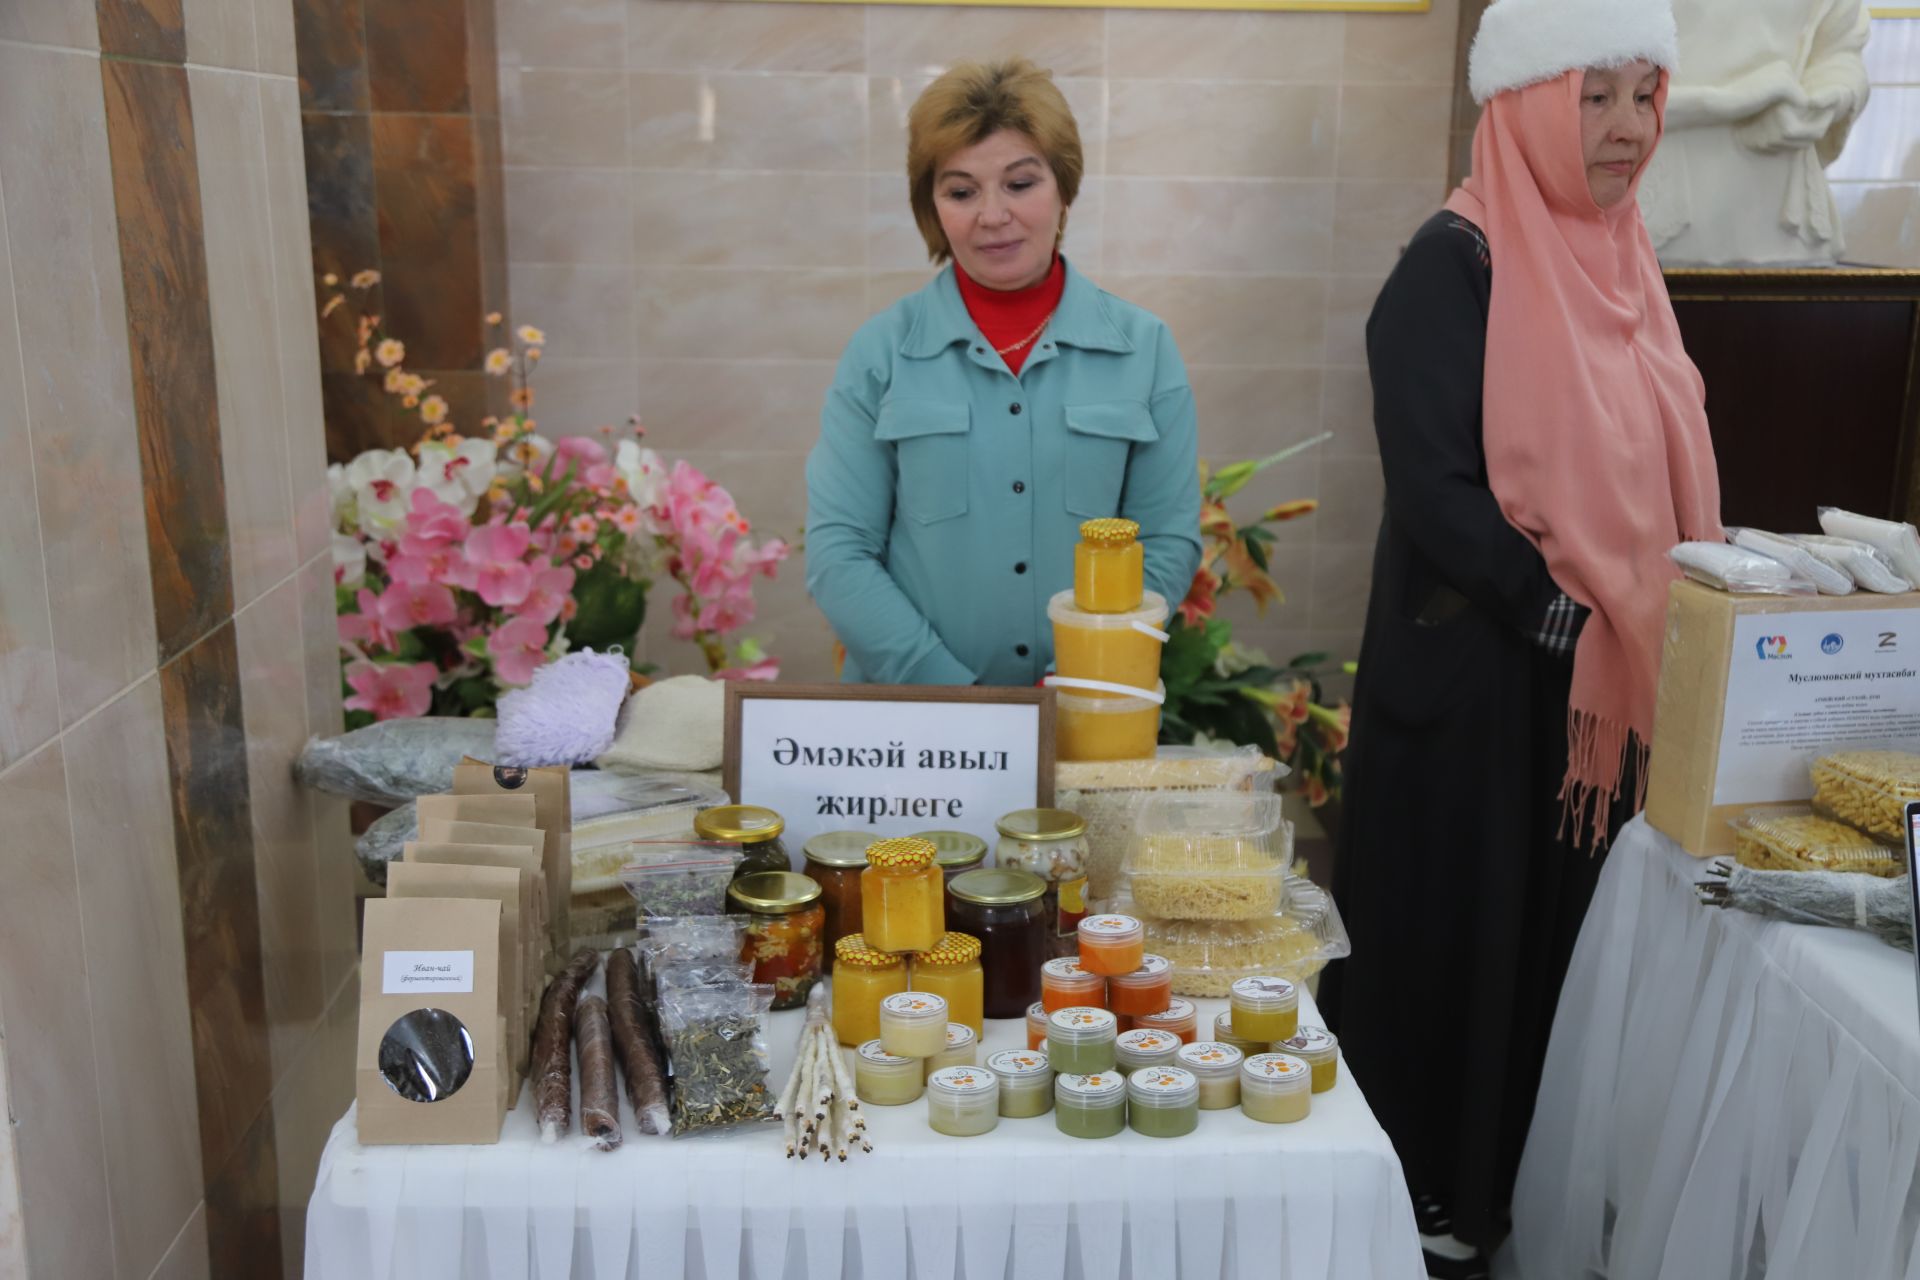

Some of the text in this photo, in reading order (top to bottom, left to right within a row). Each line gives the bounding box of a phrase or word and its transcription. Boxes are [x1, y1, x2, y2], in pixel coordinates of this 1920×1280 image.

[1788, 668, 1917, 685] Муслюмовский мухтасибат
[773, 737, 1009, 771] Әмәкәй авыл
[816, 795, 963, 824] җирлеге
[413, 964, 451, 972] Иван-чай
